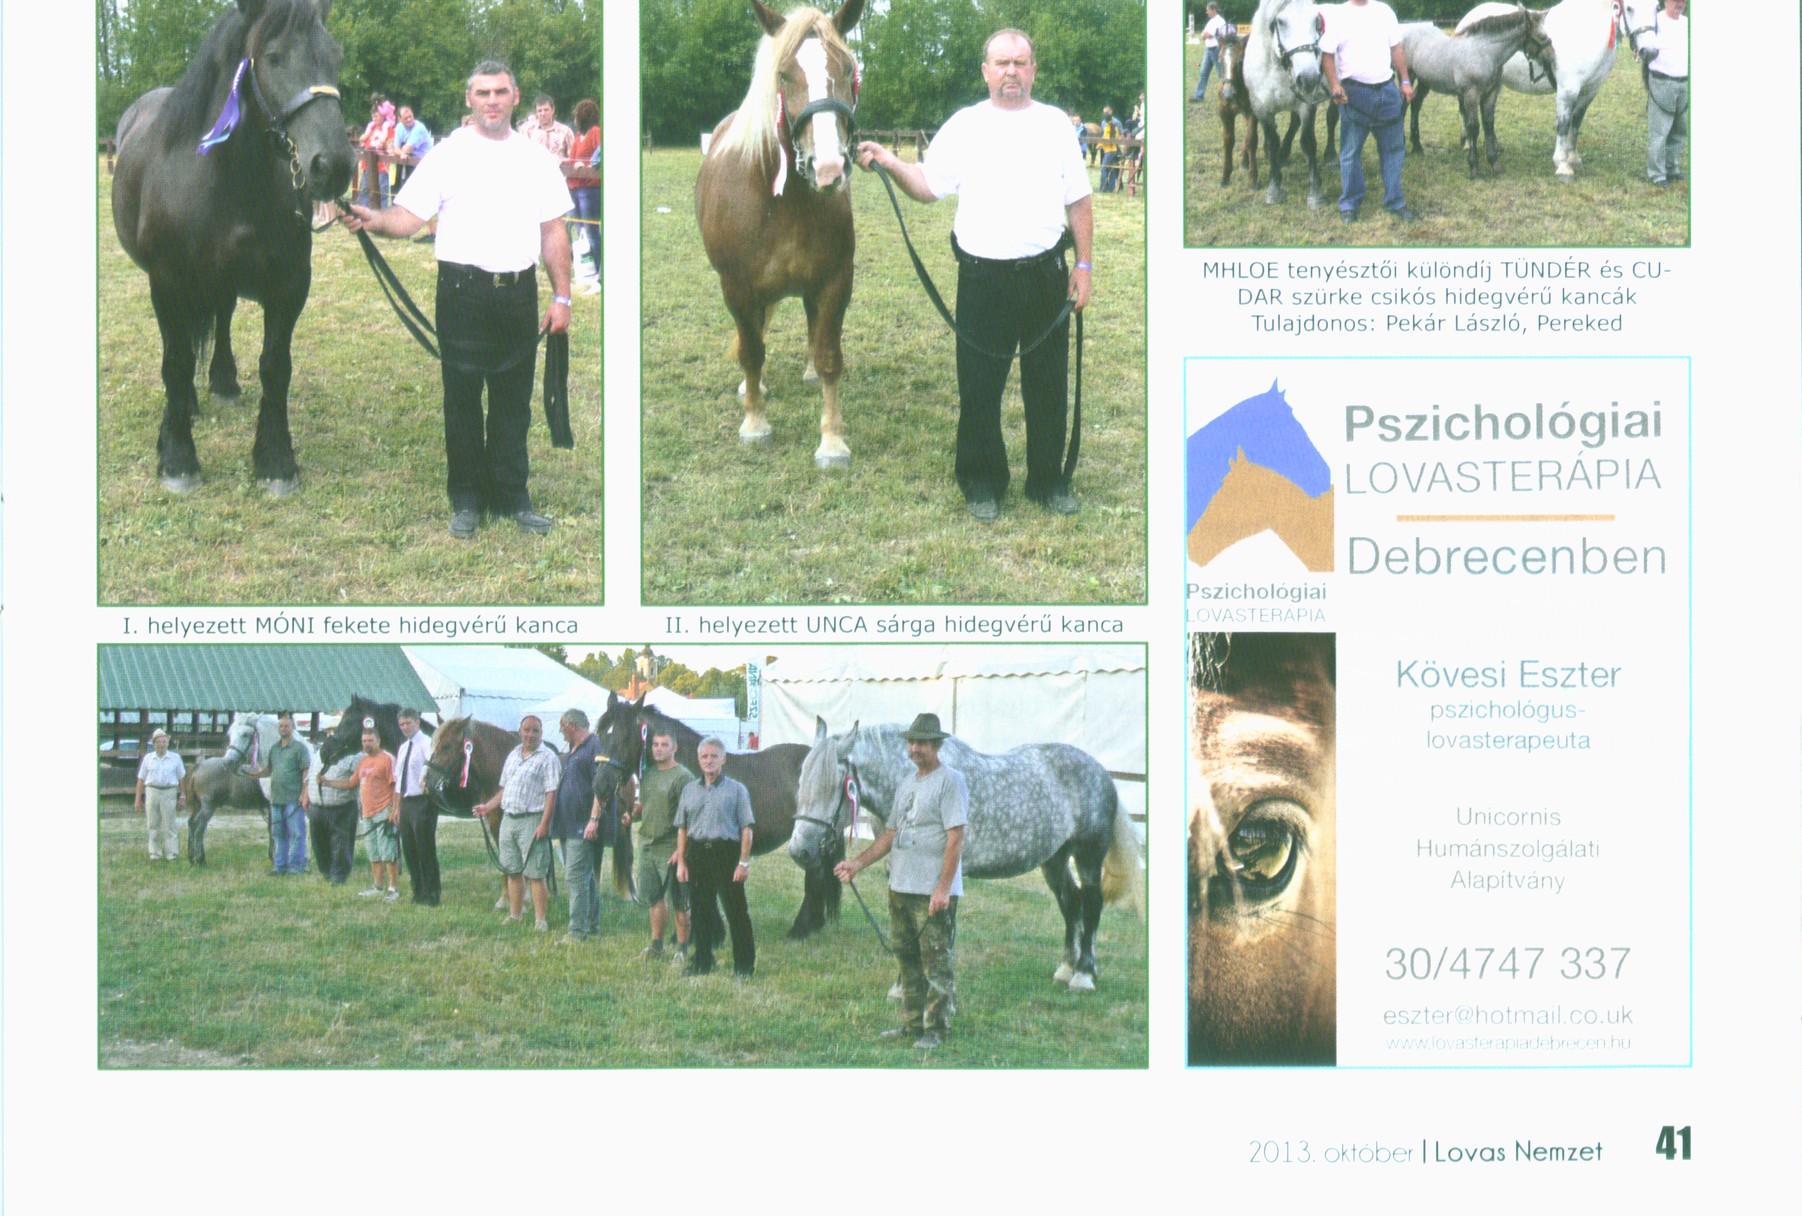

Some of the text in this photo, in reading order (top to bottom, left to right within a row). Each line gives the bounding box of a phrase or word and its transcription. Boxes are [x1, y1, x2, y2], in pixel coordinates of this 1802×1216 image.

[1204, 256, 1670, 283] MHLOE tenyésztői különdíj TÜNDÉR és CU-
[1239, 286, 1636, 309] DAR szürke csikós hidegvérű kancák
[1251, 313, 1621, 336] Tulajdonos: Pekár László, Pereked
[1346, 401, 1661, 449] Pszichológiai
[1346, 450, 1661, 494] LOVASTERÁPIA
[1349, 537, 1665, 575] Debrecenben
[1188, 583, 1326, 603] Pszichológiai
[124, 611, 577, 638] I. helyezett MÓNI fekete hidegvérű kanca
[666, 614, 1123, 637] II. helyezett UNCA sárga hidegvérű kanca
[1187, 605, 1325, 622] LOVASTERÁPIA
[1397, 660, 1622, 689] Kövesi Eszter
[1431, 699, 1585, 724] pszichológus-
[1427, 730, 1591, 754] lovasterapeuta
[1457, 807, 1561, 826] Unicornis
[1417, 839, 1599, 862] Humánszolgálati
[1451, 870, 1565, 894] Alapítvány
[1386, 946, 1631, 980] 30/4747 337
[1384, 1005, 1632, 1024] eszter@hotmail.co.uk
[1386, 1035, 1630, 1053] www.lovasterapiadebrecen.hu
[1250, 1139, 1603, 1163] 2013. október Lovas Nemzet
[1656, 1126, 1691, 1160] 41
